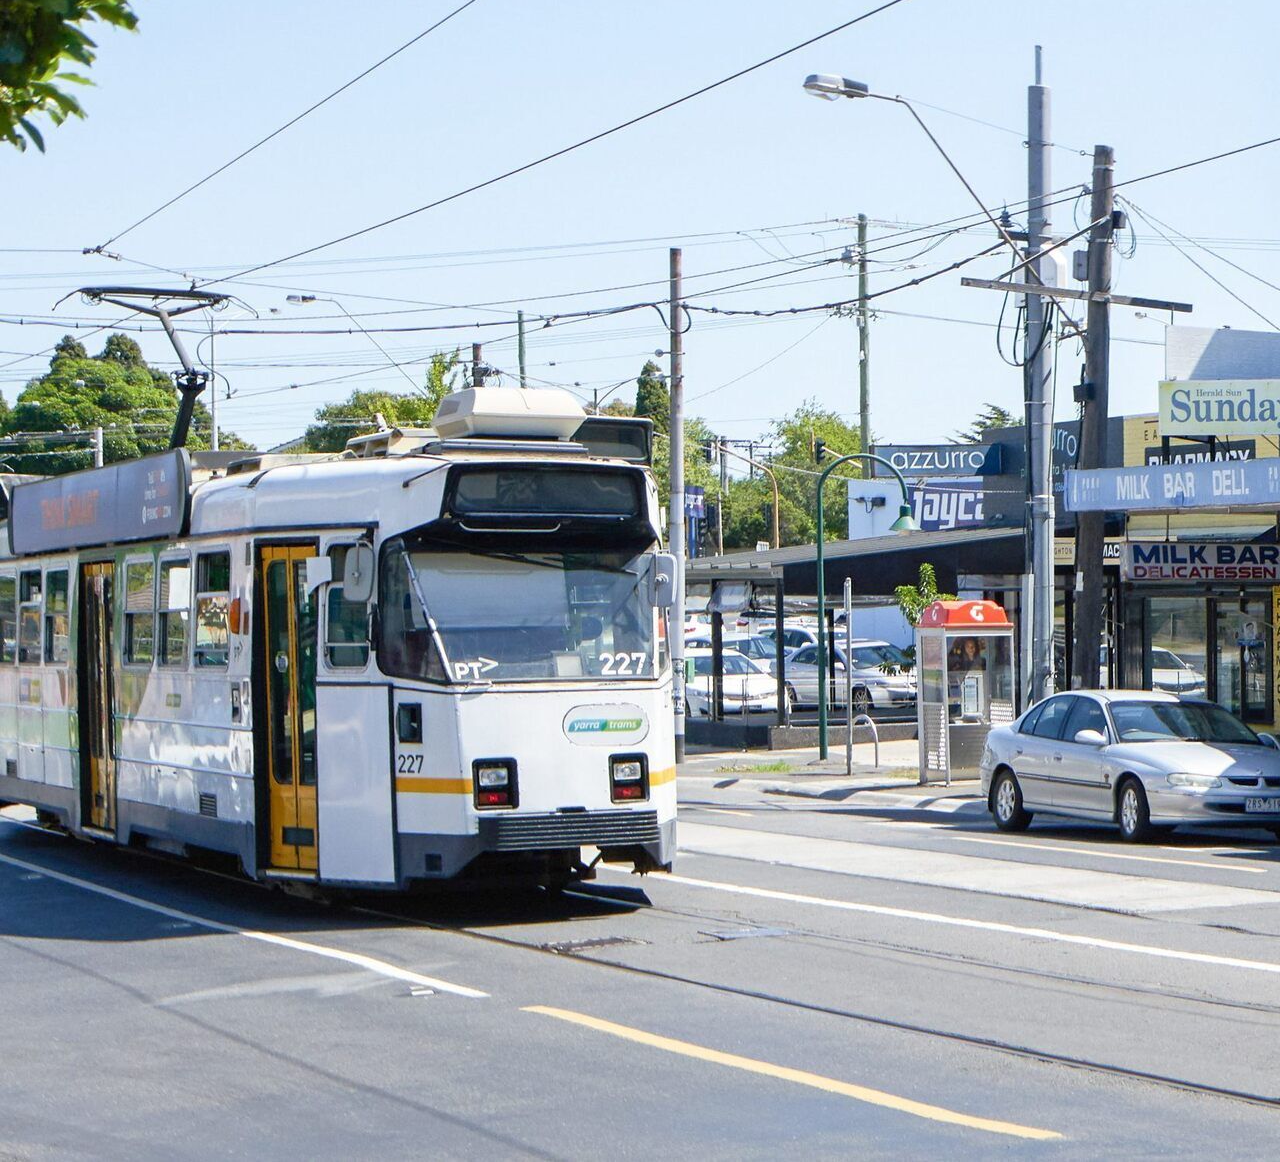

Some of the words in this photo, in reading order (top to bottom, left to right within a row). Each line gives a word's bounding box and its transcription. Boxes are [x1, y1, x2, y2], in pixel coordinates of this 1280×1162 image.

[1195, 388, 1224, 398] Herald
[1226, 389, 1243, 398] Sun
[891, 449, 986, 471] azzurro
[1116, 474, 1150, 501] MILK
[1163, 471, 1196, 499] BAR
[1133, 544, 1208, 564] MILK
[1216, 545, 1280, 565] BAR
[1133, 565, 1277, 580] DELICATESSEN
[599, 652, 647, 675] 227
[572, 720, 600, 732] yarra
[608, 719, 638, 730] trams
[398, 755, 424, 774] 227
